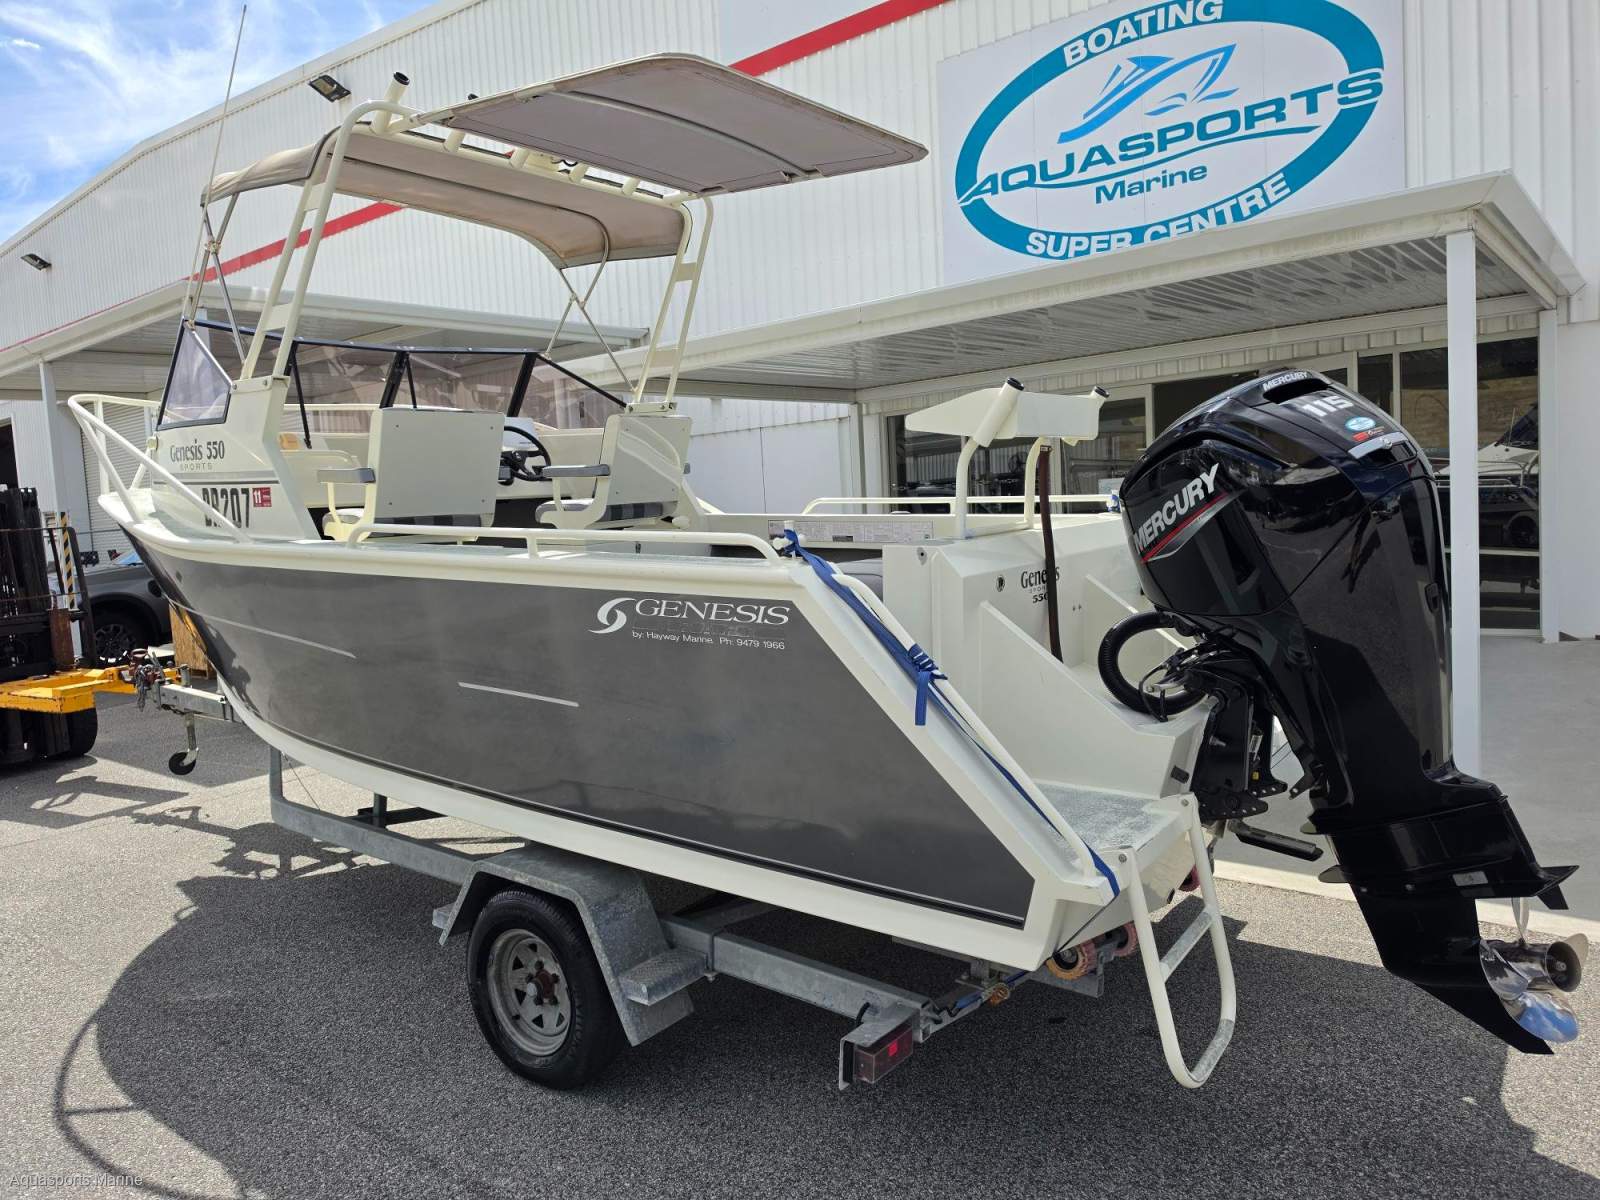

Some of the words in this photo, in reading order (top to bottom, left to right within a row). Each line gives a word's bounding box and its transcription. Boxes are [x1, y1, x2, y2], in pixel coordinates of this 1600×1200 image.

[1063, 0, 1223, 67] BOATING
[959, 71, 1383, 204] AQUASPORTS
[1095, 165, 1207, 204] Marine
[1026, 231, 1132, 257] SUPER
[1262, 371, 1307, 391] MERCURY
[1302, 396, 1353, 417] 115
[170, 439, 203, 462] Genesis
[206, 440, 225, 460] 550
[1134, 463, 1219, 554] MERCURY
[1021, 566, 1060, 589] Genes
[635, 599, 790, 625] GENESIS
[632, 630, 644, 639] by:
[647, 631, 680, 643] Hayway
[719, 637, 734, 646] Ph:
[736, 638, 760, 648] 9479
[763, 640, 785, 649] 1966
